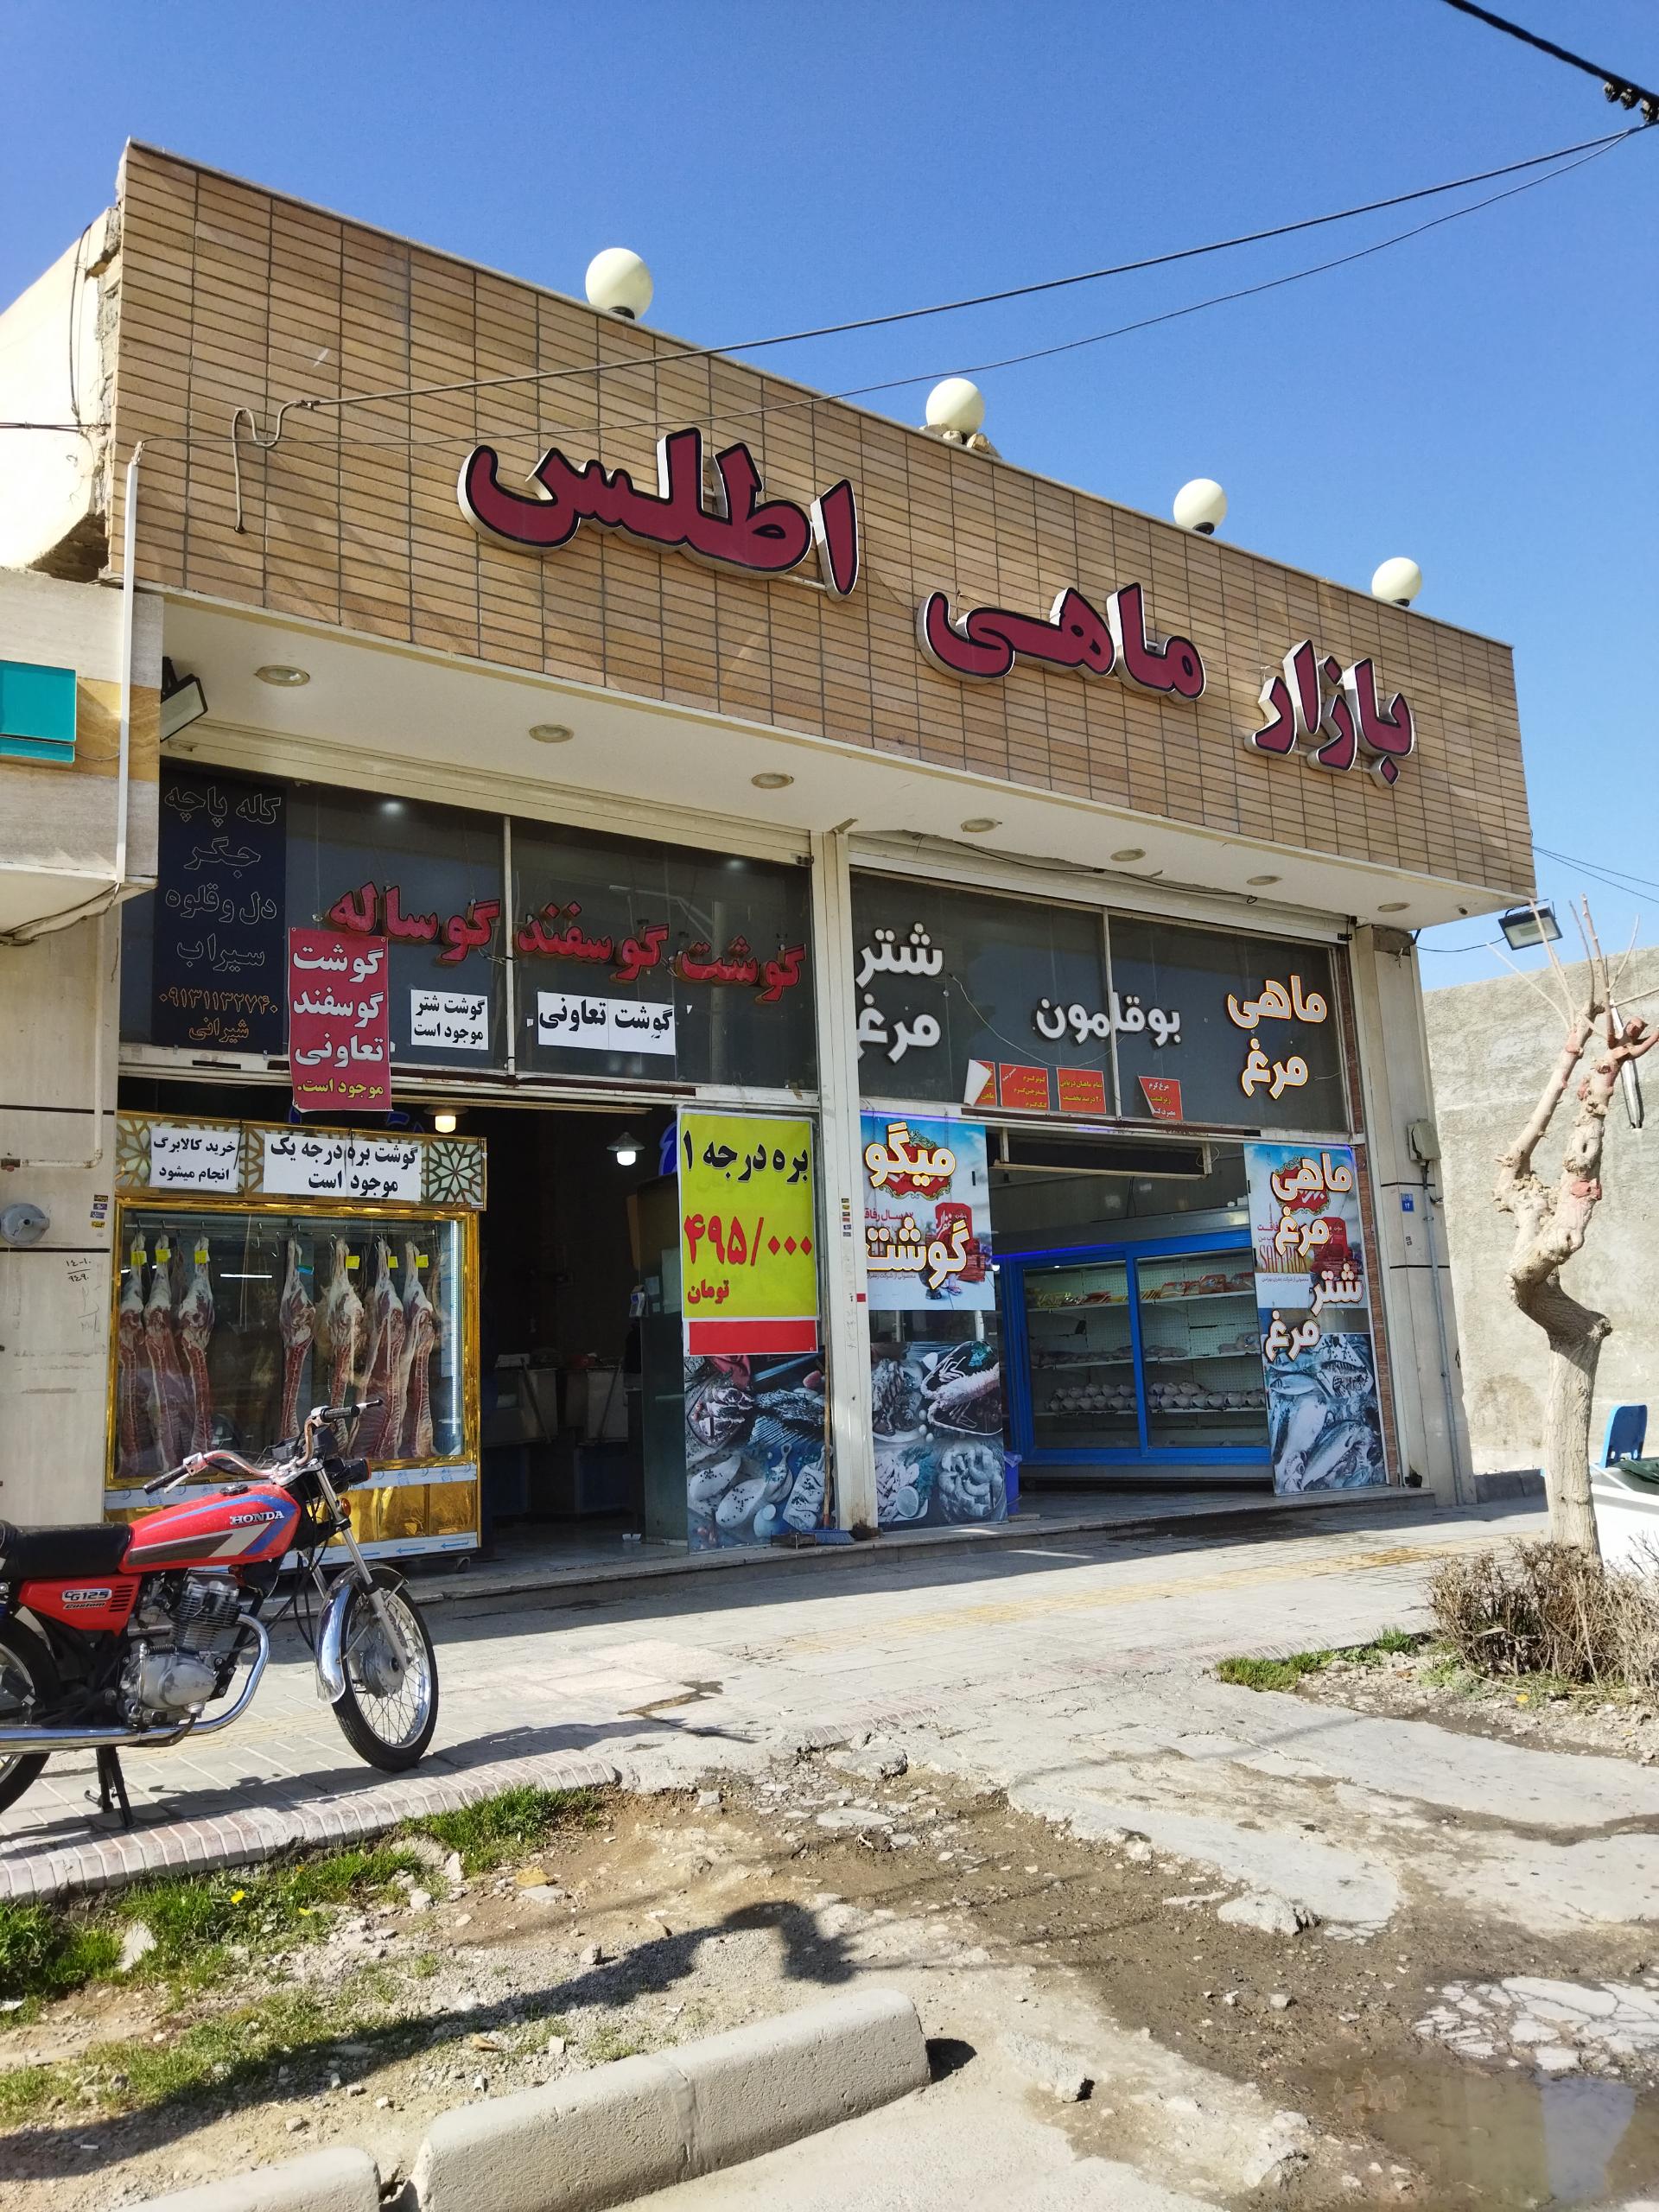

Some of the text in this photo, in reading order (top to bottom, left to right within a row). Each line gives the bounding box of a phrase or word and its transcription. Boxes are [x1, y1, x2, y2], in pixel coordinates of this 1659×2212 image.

[919, 582, 1205, 701] ماهی
[1245, 639, 1414, 787] بازار
[164, 785, 282, 827] کله پاچه
[184, 836, 261, 879] جگر
[239, 892, 277, 925] دل
[176, 933, 265, 974] سیراب
[327, 881, 806, 1003] گوشت گوسفند گوساله
[855, 921, 944, 988] شتر
[293, 944, 384, 983] گوشت
[159, 987, 278, 1014] ۰۹۱۳۱۱۳۲۷۴۰
[293, 987, 384, 1028] گوسفند
[416, 995, 486, 1020] گوشت شتر
[539, 996, 673, 1039] گوشت تعاونی
[1035, 989, 1182, 1046] بوقلمون
[1227, 975, 1327, 1029] ماهی
[188, 1017, 250, 1044] شیرانی
[414, 1022, 484, 1045] موجود است
[857, 992, 942, 1065] مرغ
[295, 1032, 384, 1069] تعاونی
[1242, 1038, 1308, 1099] مرغ
[337, 1081, 384, 1099] موجود
[154, 1136, 237, 1157] خرید کالابرگ
[270, 1137, 418, 1170] گوشت بره درجه یک
[702, 1141, 767, 1183] درجه
[772, 1143, 809, 1184] بره
[865, 1122, 956, 1187] میگو
[198, 1166, 230, 1183] انجام
[308, 1171, 398, 1198] موجود است
[1271, 1153, 1352, 1201] ماهی
[1275, 1205, 1330, 1257] مرغ
[866, 1217, 969, 1290] گوشت
[687, 1280, 730, 1304] تومان
[1311, 1262, 1363, 1317] شتر
[1265, 1309, 1320, 1363] مرغ
[230, 1510, 284, 1524] HONDA
